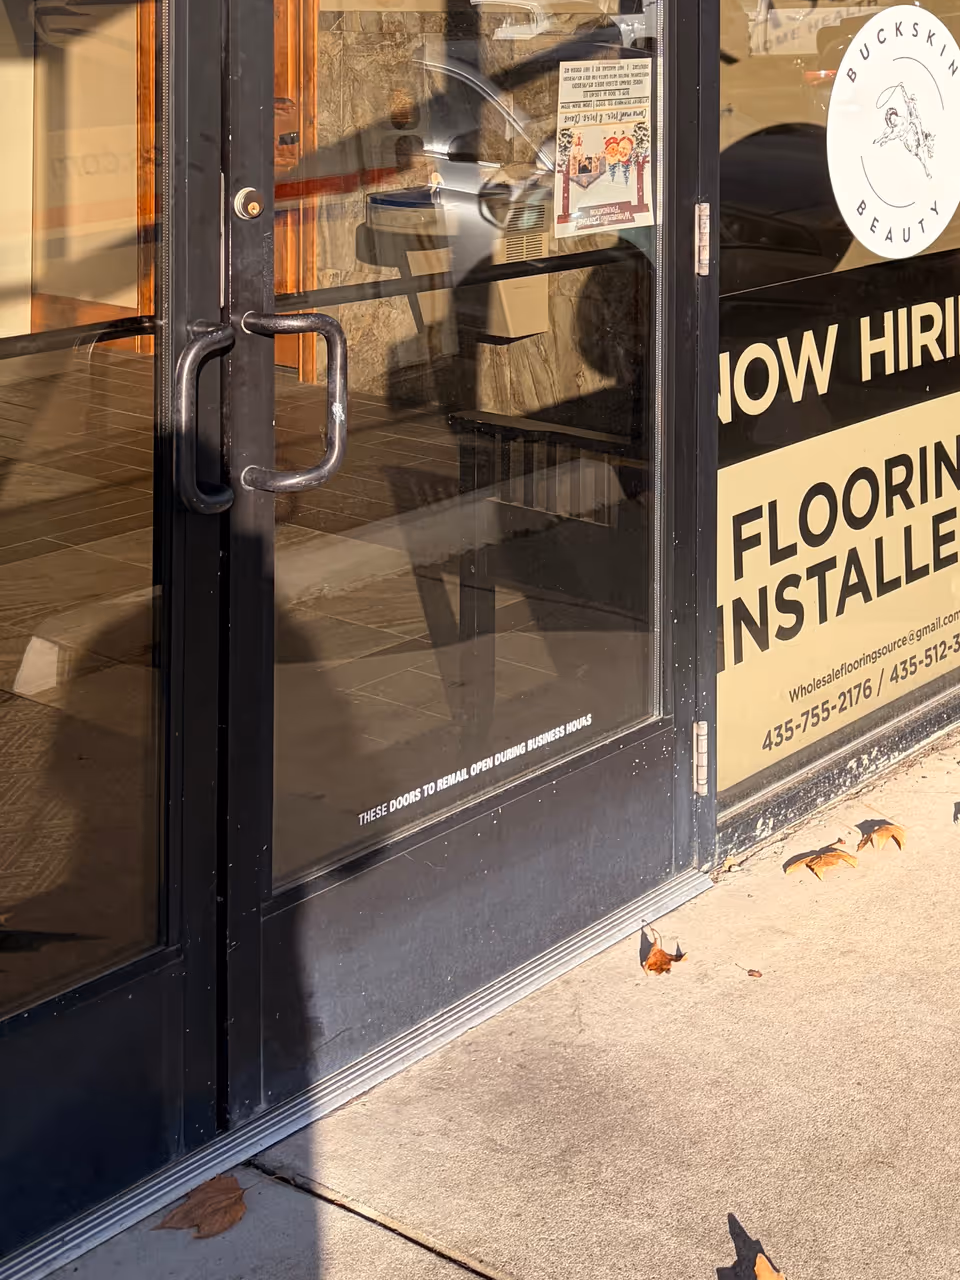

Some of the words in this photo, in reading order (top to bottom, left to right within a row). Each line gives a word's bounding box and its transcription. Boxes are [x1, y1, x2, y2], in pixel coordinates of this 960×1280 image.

[847, 21, 959, 83] BUCKSKIN
[856, 199, 939, 243] BEAUTY
[762, 678, 872, 751] 435-755-2176
[358, 803, 388, 826] THESE
[389, 788, 421, 812] DOORS
[423, 782, 435, 797] TO
[470, 756, 493, 776] OPEN
[495, 741, 526, 765] DURING
[527, 725, 565, 752] BUSINESS
